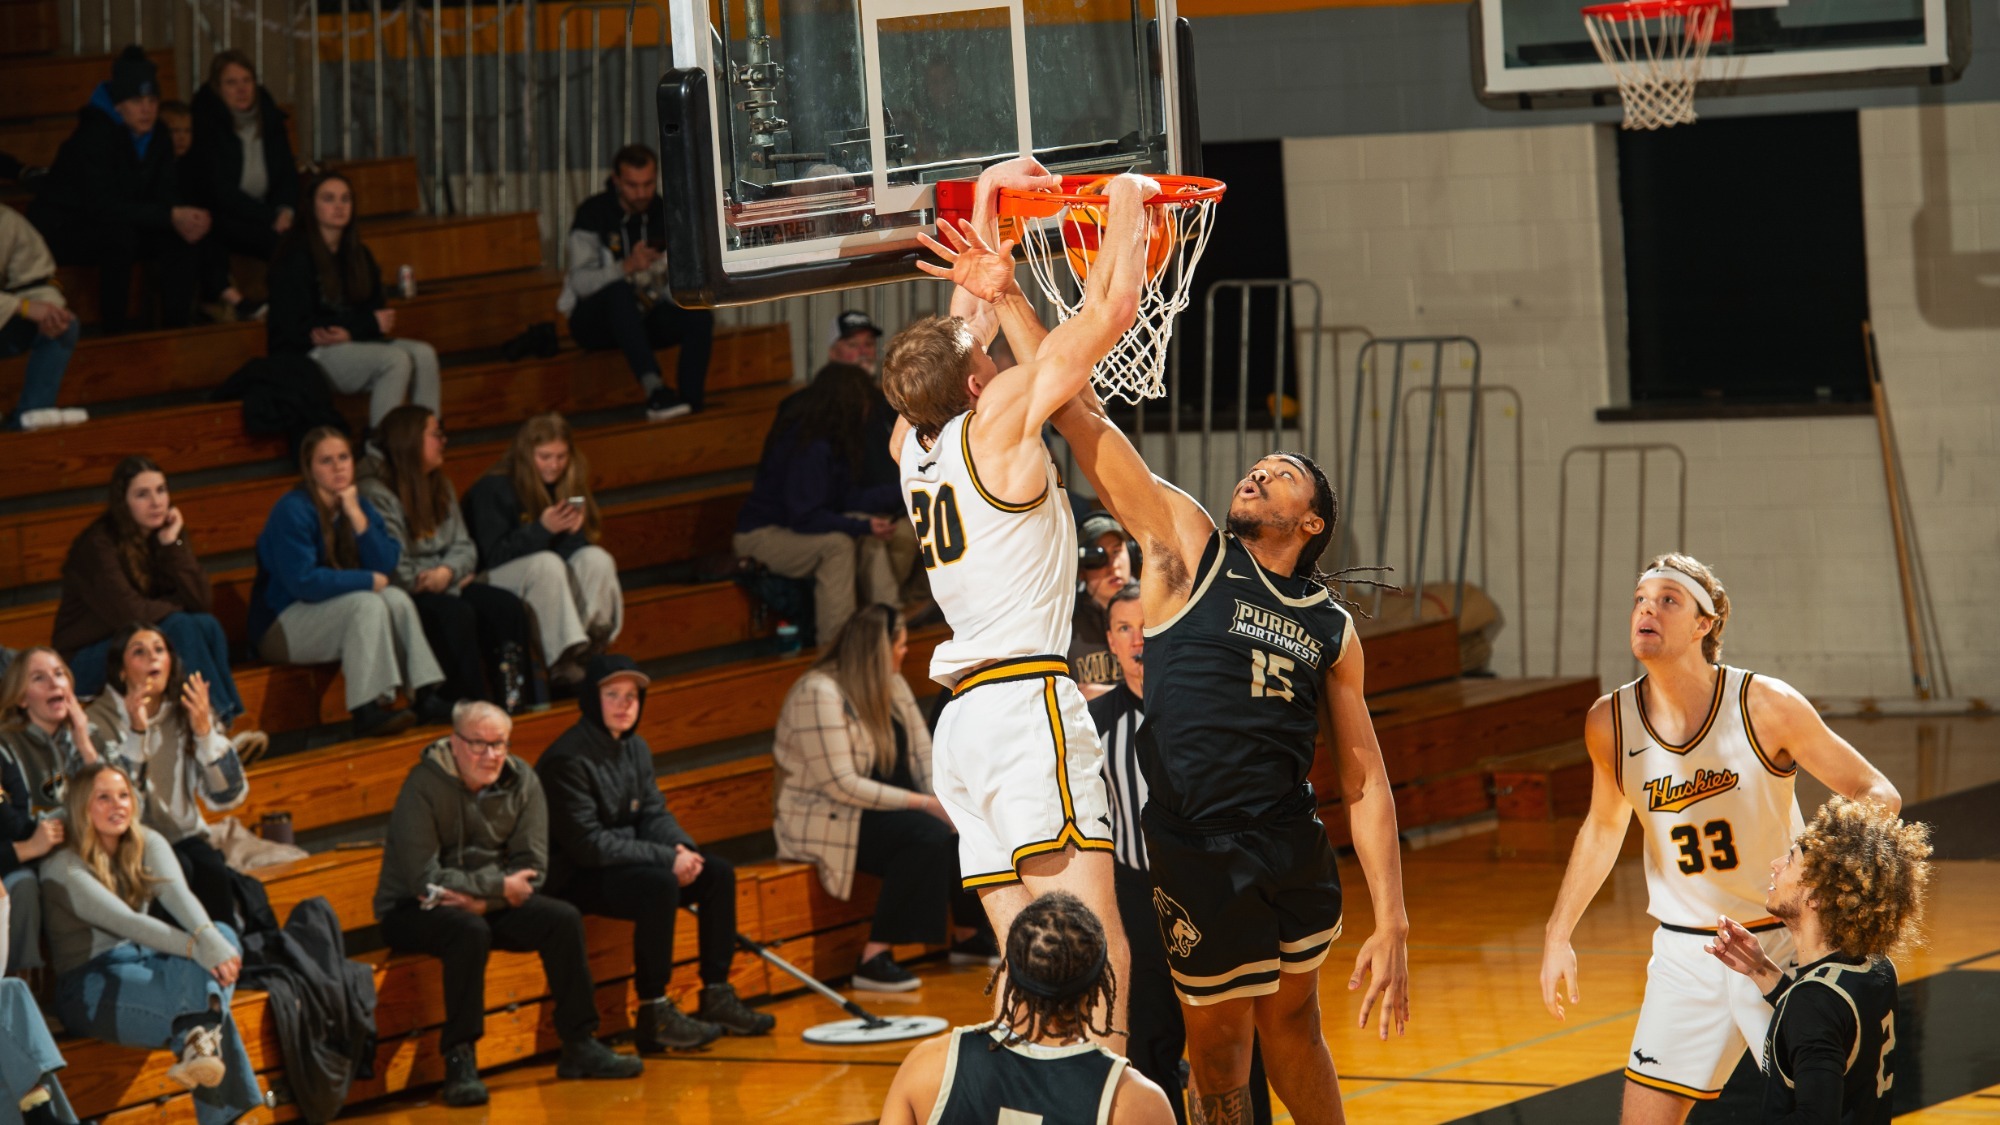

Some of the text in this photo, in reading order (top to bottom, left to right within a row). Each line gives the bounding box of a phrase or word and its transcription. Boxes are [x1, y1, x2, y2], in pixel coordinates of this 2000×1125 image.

[911, 482, 968, 571] 20
[1251, 649, 1295, 702] 15
[1643, 768, 1739, 813] Huskies
[1670, 818, 1740, 877] 33
[1876, 1008, 1896, 1098] 2
